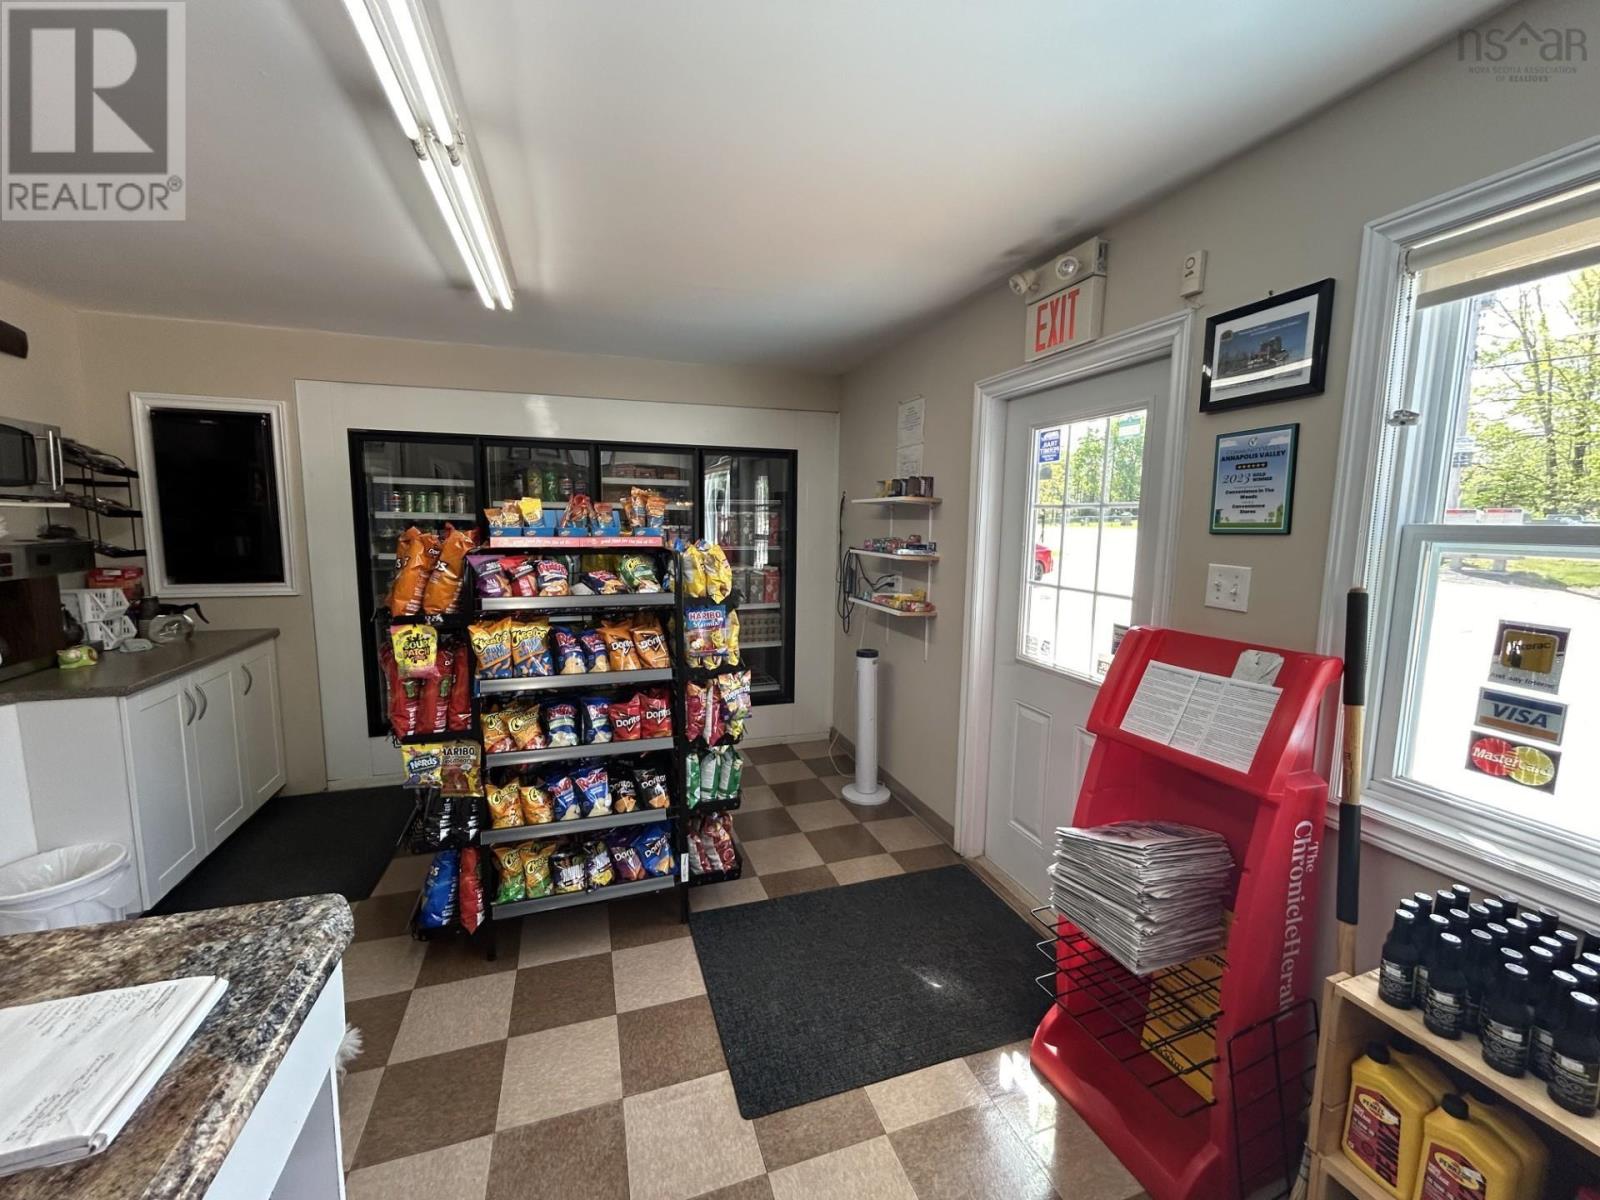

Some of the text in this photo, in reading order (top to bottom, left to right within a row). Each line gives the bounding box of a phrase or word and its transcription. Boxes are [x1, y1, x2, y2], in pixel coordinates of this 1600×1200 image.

[1035, 288, 1080, 353] EXIT
[1221, 453, 1258, 462] ANNAPOLIS
[1259, 449, 1286, 459] VALLEY
[688, 610, 721, 621] HARIBO
[512, 626, 546, 647] Cheetos
[616, 714, 640, 729] Doritos
[646, 708, 671, 720] Doritos
[1492, 703, 1549, 728] VISA
[1305, 841, 1319, 873] The
